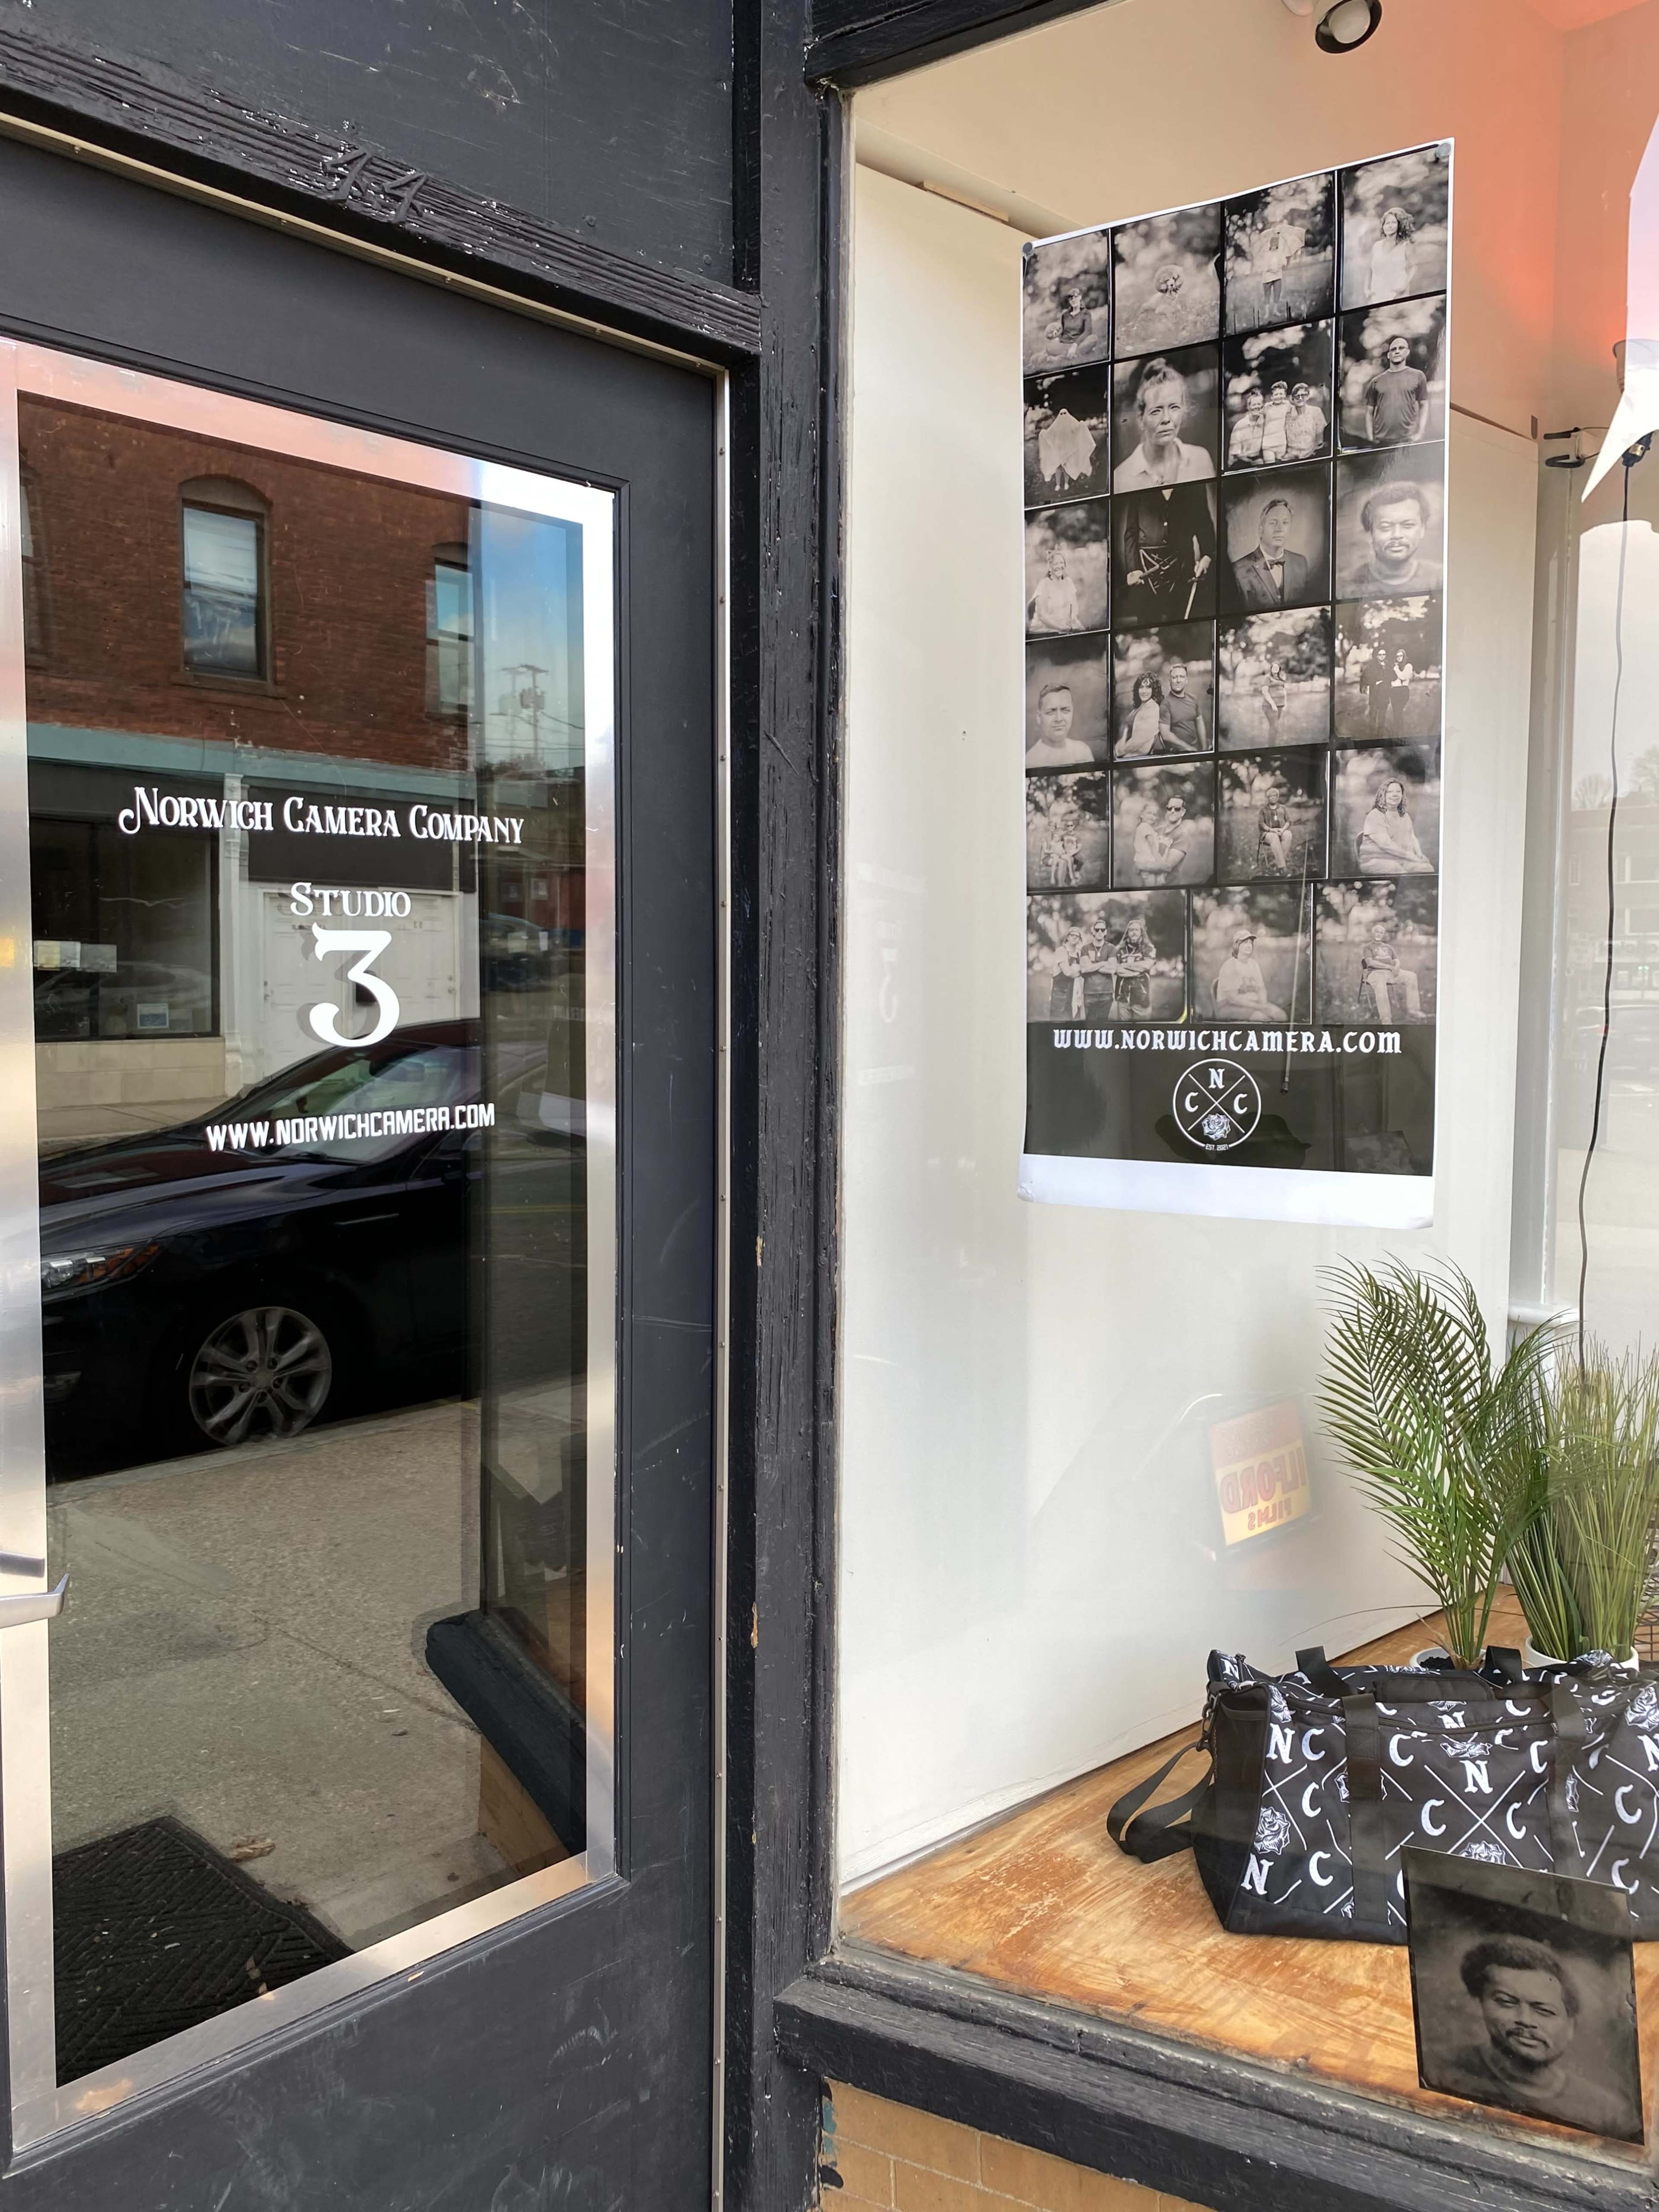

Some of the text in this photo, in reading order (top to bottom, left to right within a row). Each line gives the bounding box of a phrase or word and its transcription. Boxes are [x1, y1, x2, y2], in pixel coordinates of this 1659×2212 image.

[119, 787, 524, 844] NORWICH CAMERA COMPANY
[290, 882, 411, 917] STUDIO
[309, 922, 400, 1047] 3
[1208, 1068, 1225, 1089] N
[1185, 1092, 1248, 1114] C C
[207, 1103, 495, 1151] WWW.NORWICHCAMERA.COM
[1266, 1723, 1295, 1764] N
[1301, 1728, 1325, 1761] C
[1389, 1733, 1414, 1767] C
[1530, 1740, 1548, 1773] C
[1459, 1760, 1494, 1794] N
[1301, 1781, 1322, 1818] C
[1421, 1799, 1446, 1836] C
[1615, 1784, 1642, 1824] C
[1506, 1802, 1526, 1840] C
[1240, 1853, 1274, 1895] N
[1309, 1851, 1334, 1887] C
[1611, 1858, 1640, 1895] C
